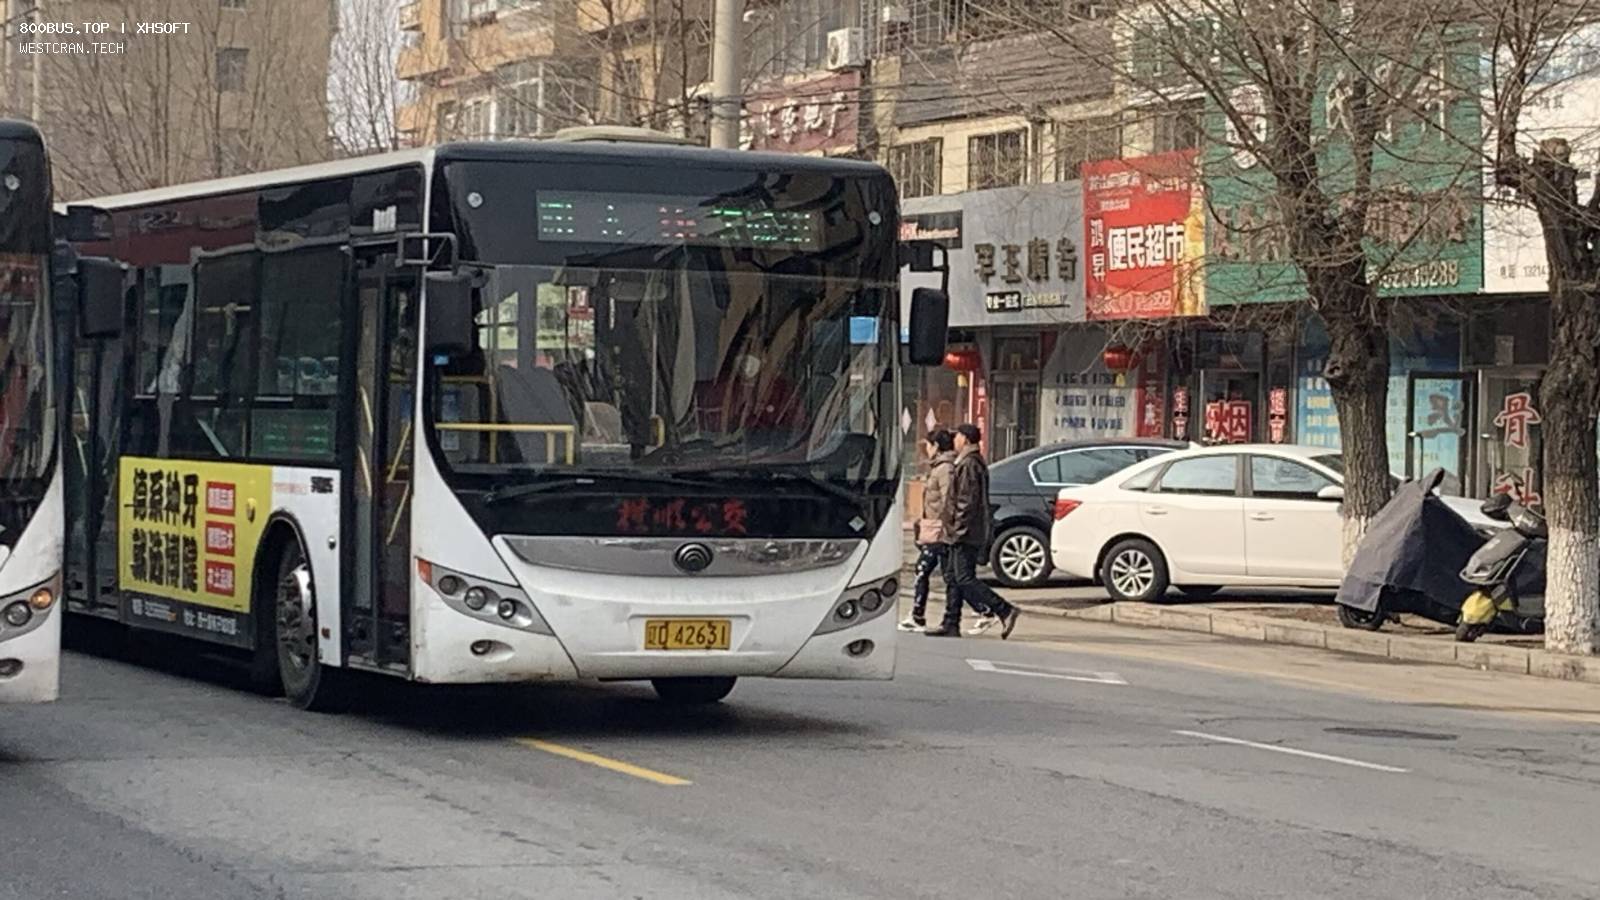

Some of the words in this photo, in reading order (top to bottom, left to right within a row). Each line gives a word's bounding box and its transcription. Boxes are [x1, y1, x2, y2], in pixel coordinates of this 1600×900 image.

[1108, 220, 1184, 270] 便民超市
[674, 624, 726, 646] 42631
